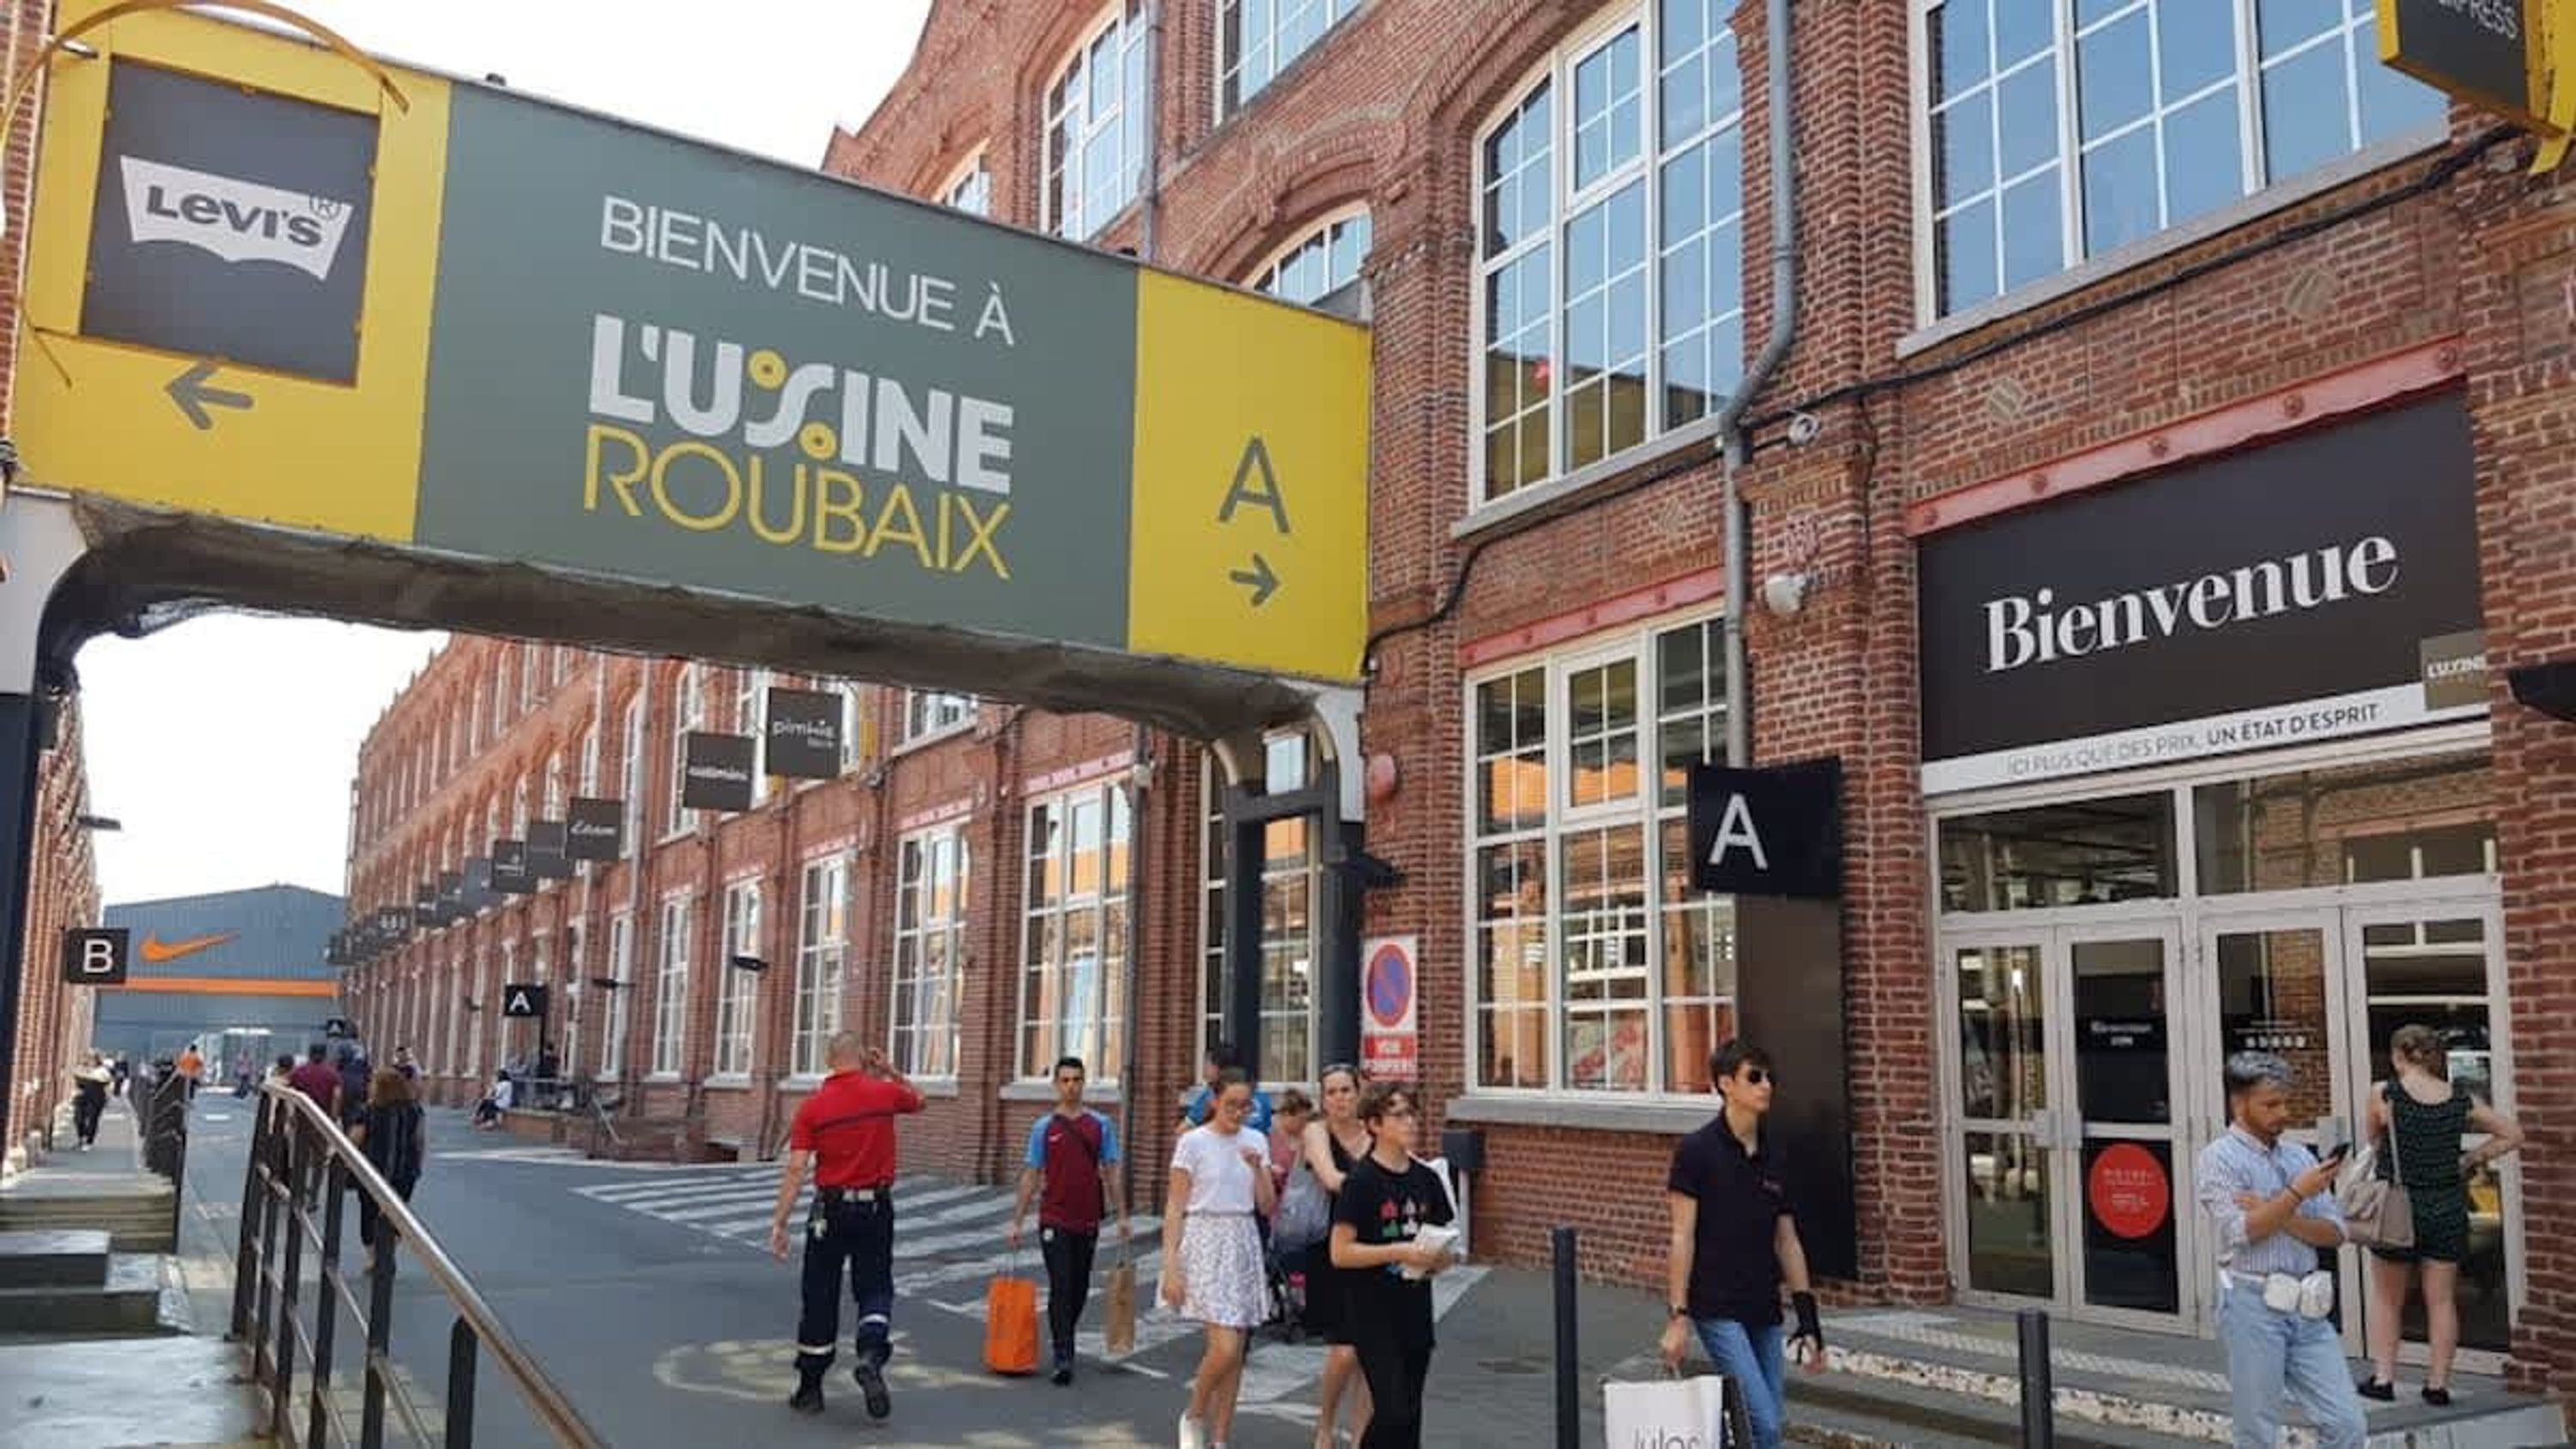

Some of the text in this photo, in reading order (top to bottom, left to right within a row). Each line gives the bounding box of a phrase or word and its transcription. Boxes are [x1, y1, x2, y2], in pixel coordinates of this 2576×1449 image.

[600, 195, 1015, 346] BIENVENUE À
[589, 313, 1014, 494] L'USINE
[584, 423, 1012, 580] ROUBAIX
[1218, 436, 1290, 533] A
[1982, 536, 2399, 673] Bienvenue
[2206, 724, 2236, 746] UN
[2289, 703, 2379, 735] D'ESPRIT
[1709, 792, 1769, 870] A
[83, 939, 112, 973] B
[509, 991, 531, 1013] A
